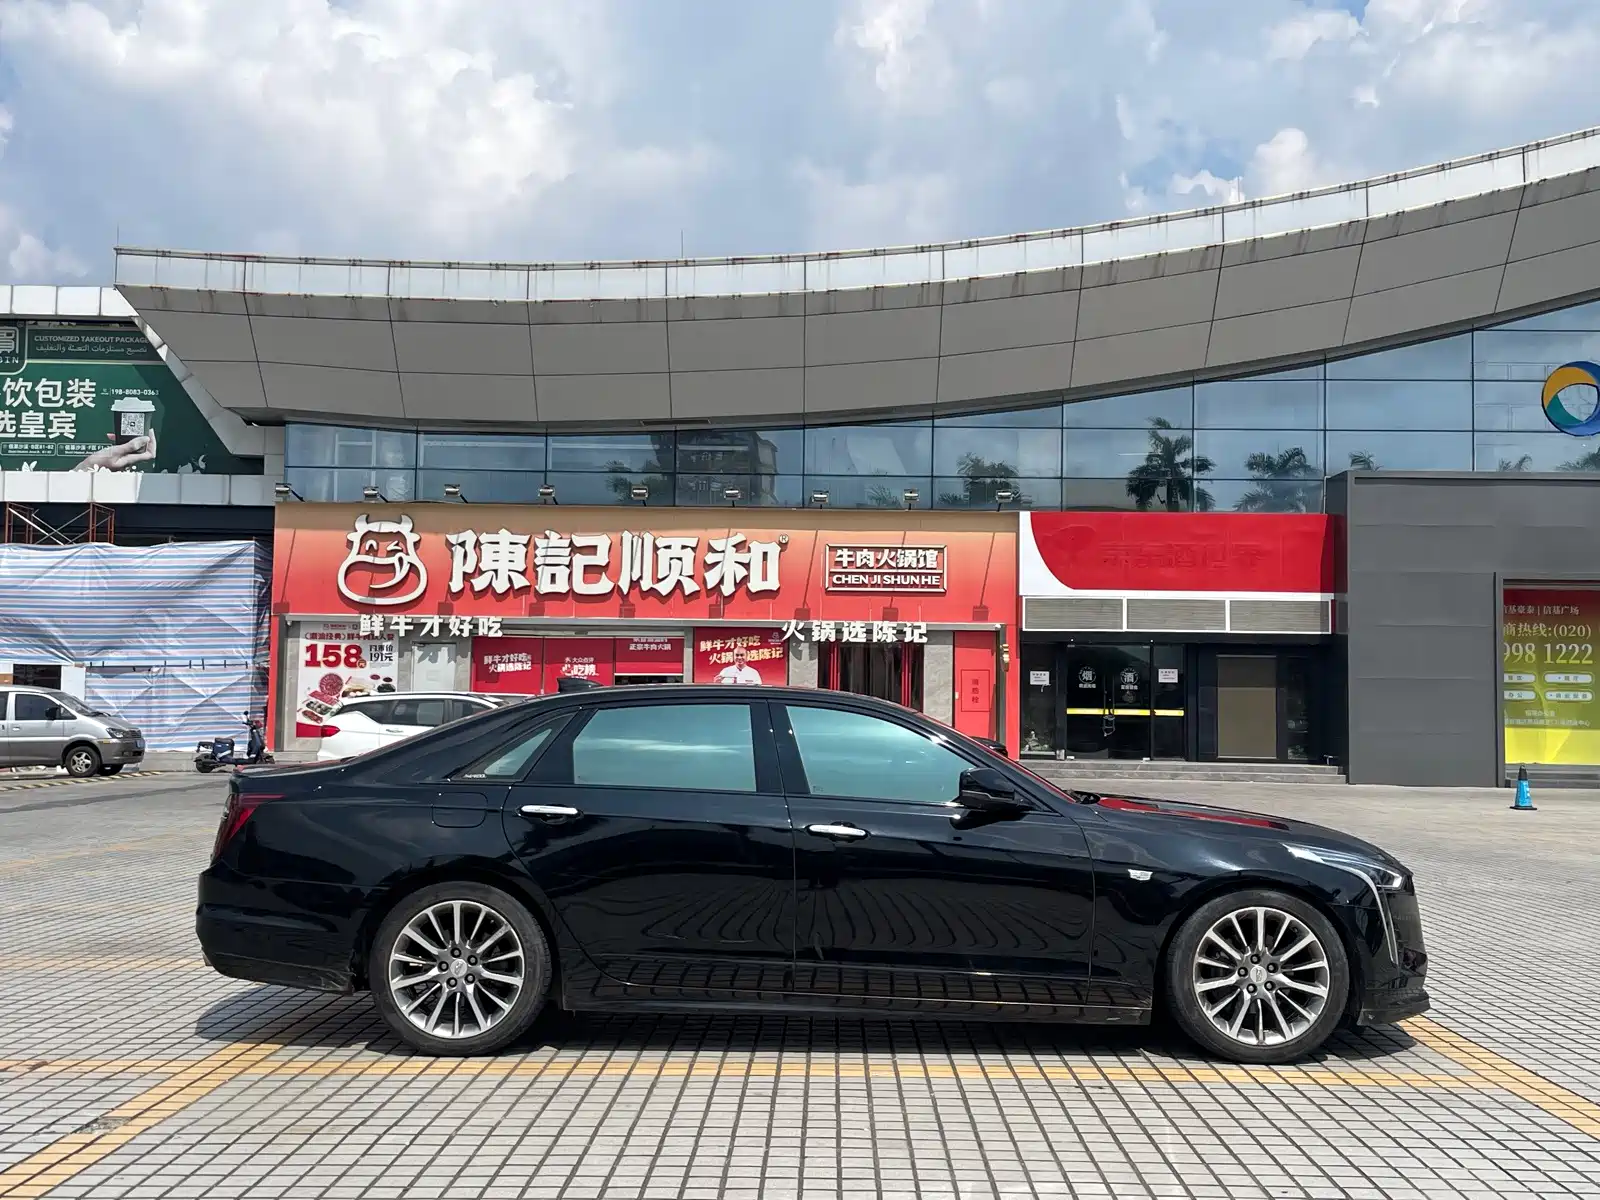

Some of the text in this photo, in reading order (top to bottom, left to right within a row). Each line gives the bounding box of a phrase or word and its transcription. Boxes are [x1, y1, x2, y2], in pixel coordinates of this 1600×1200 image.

[0, 377, 96, 408] 饮包装
[446, 528, 781, 597] 陳記顺和
[835, 548, 938, 568] 牛肉火锅馆
[832, 575, 940, 585] CHEN JI SHUN HE
[360, 614, 503, 637] 鲜牛才好吃
[782, 619, 928, 643] 火锅选陈记
[700, 635, 761, 653] 鲜牛才好吃
[1544, 643, 1593, 664] 1222
[304, 644, 362, 668] 158
[370, 652, 394, 662] 191元
[1082, 670, 1093, 681] 烟
[1123, 672, 1134, 683] 酒
